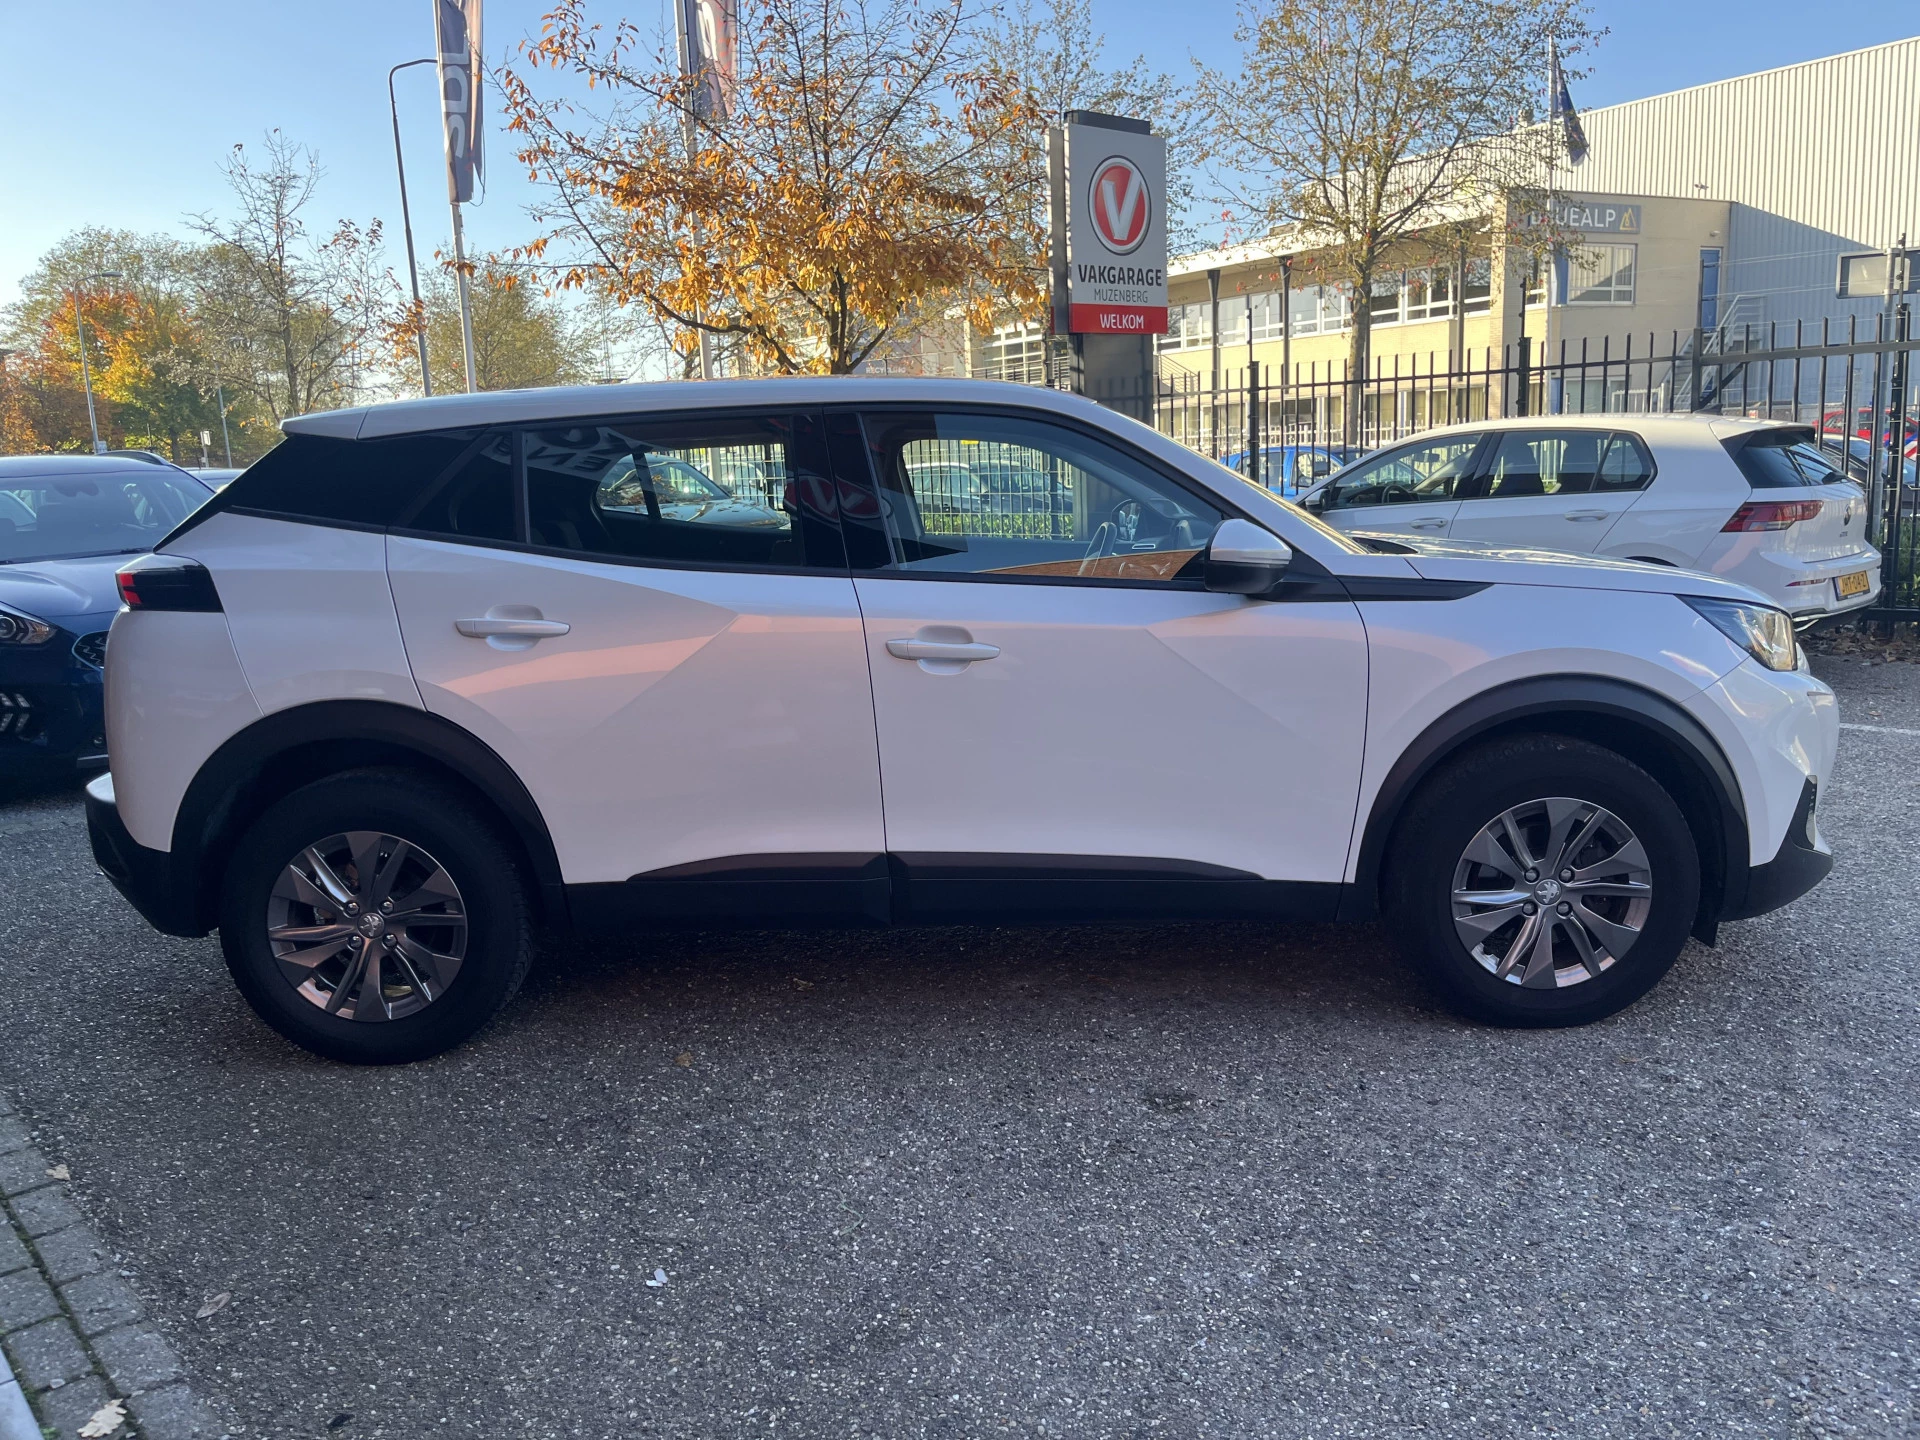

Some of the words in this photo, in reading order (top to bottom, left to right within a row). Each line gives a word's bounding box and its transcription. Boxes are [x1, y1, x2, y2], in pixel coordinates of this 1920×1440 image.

[1101, 167, 1143, 241] V
[1530, 207, 1617, 229] UEALP
[1077, 264, 1163, 287] VAKGARAGE
[1093, 288, 1149, 304] MUZENBERG
[1099, 313, 1145, 330] WELKOM
